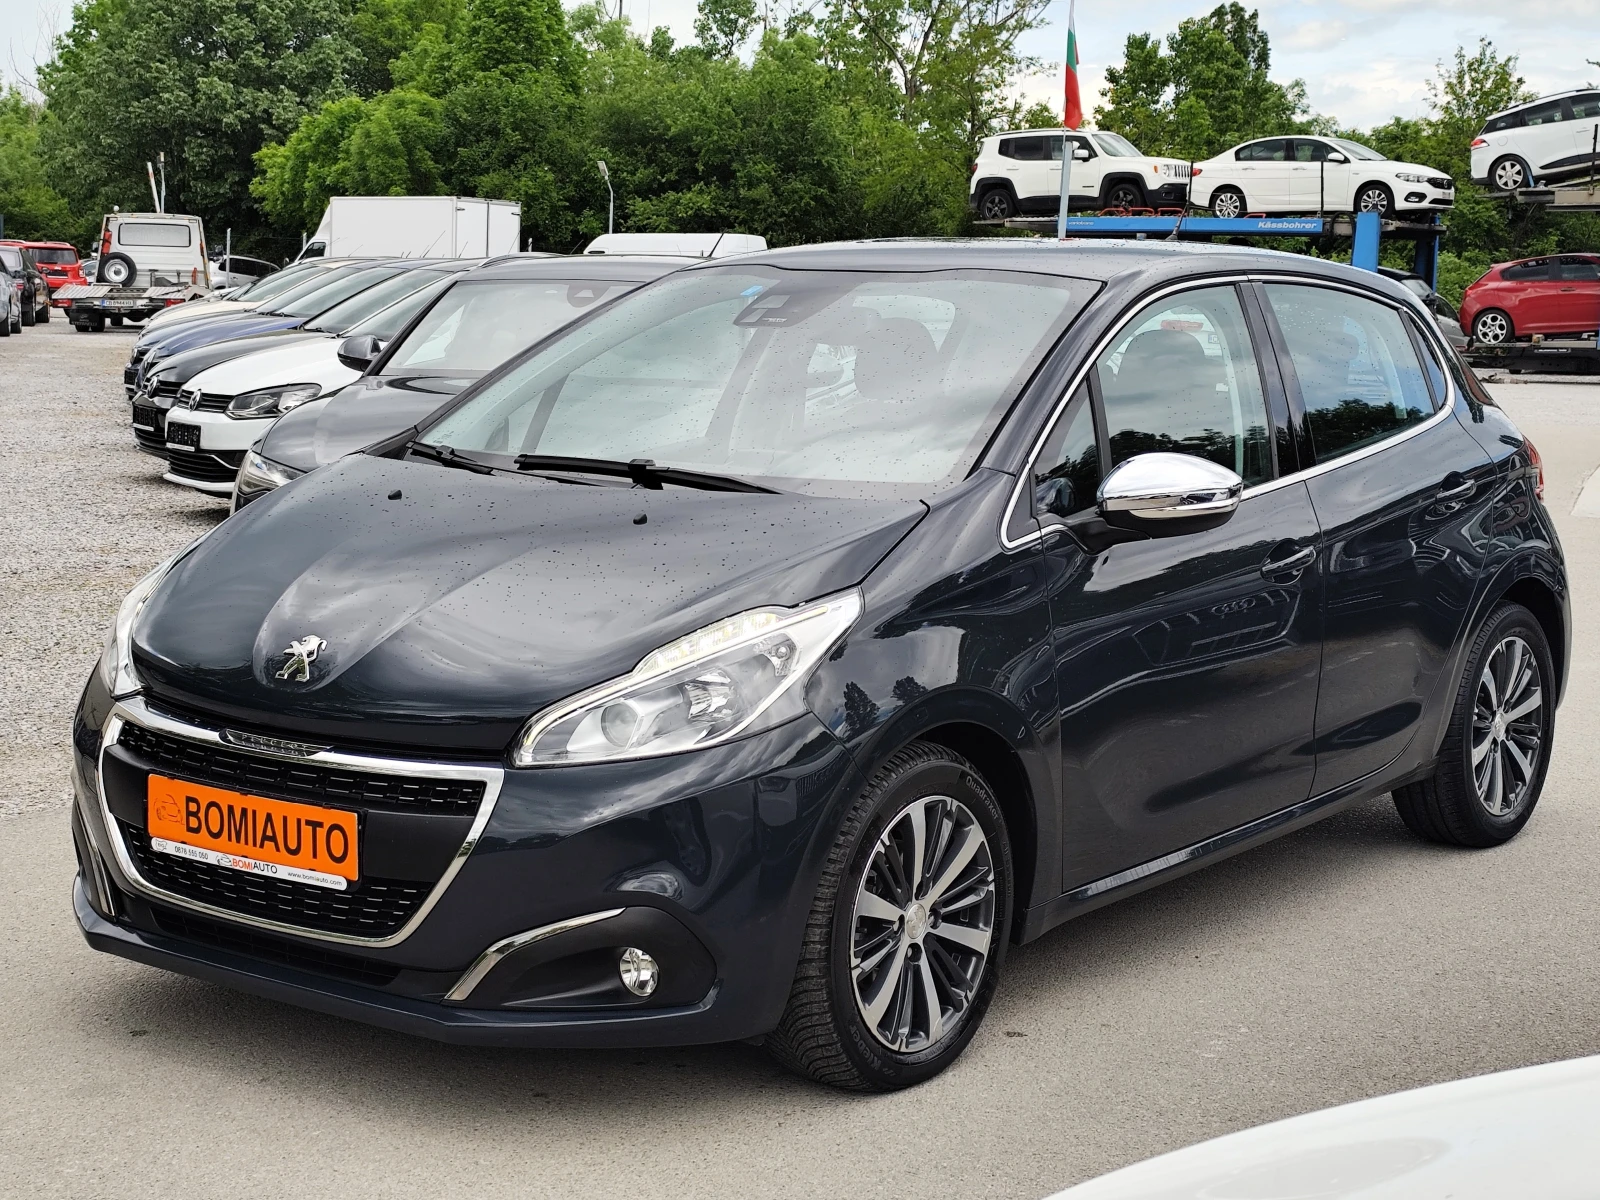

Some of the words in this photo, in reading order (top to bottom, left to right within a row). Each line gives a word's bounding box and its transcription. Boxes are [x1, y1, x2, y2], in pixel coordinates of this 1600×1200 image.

[1258, 221, 1317, 229] Kässbohrer
[965, 775, 999, 820] Quadraxer
[185, 795, 349, 864] BOMIAUTO
[174, 845, 187, 855] 0878
[188, 848, 198, 858] 555
[198, 851, 209, 860] 050
[232, 858, 278, 874] BOMIAUTO
[287, 871, 343, 886] www.bomiauto.com
[849, 1025, 882, 1071] Kleber
